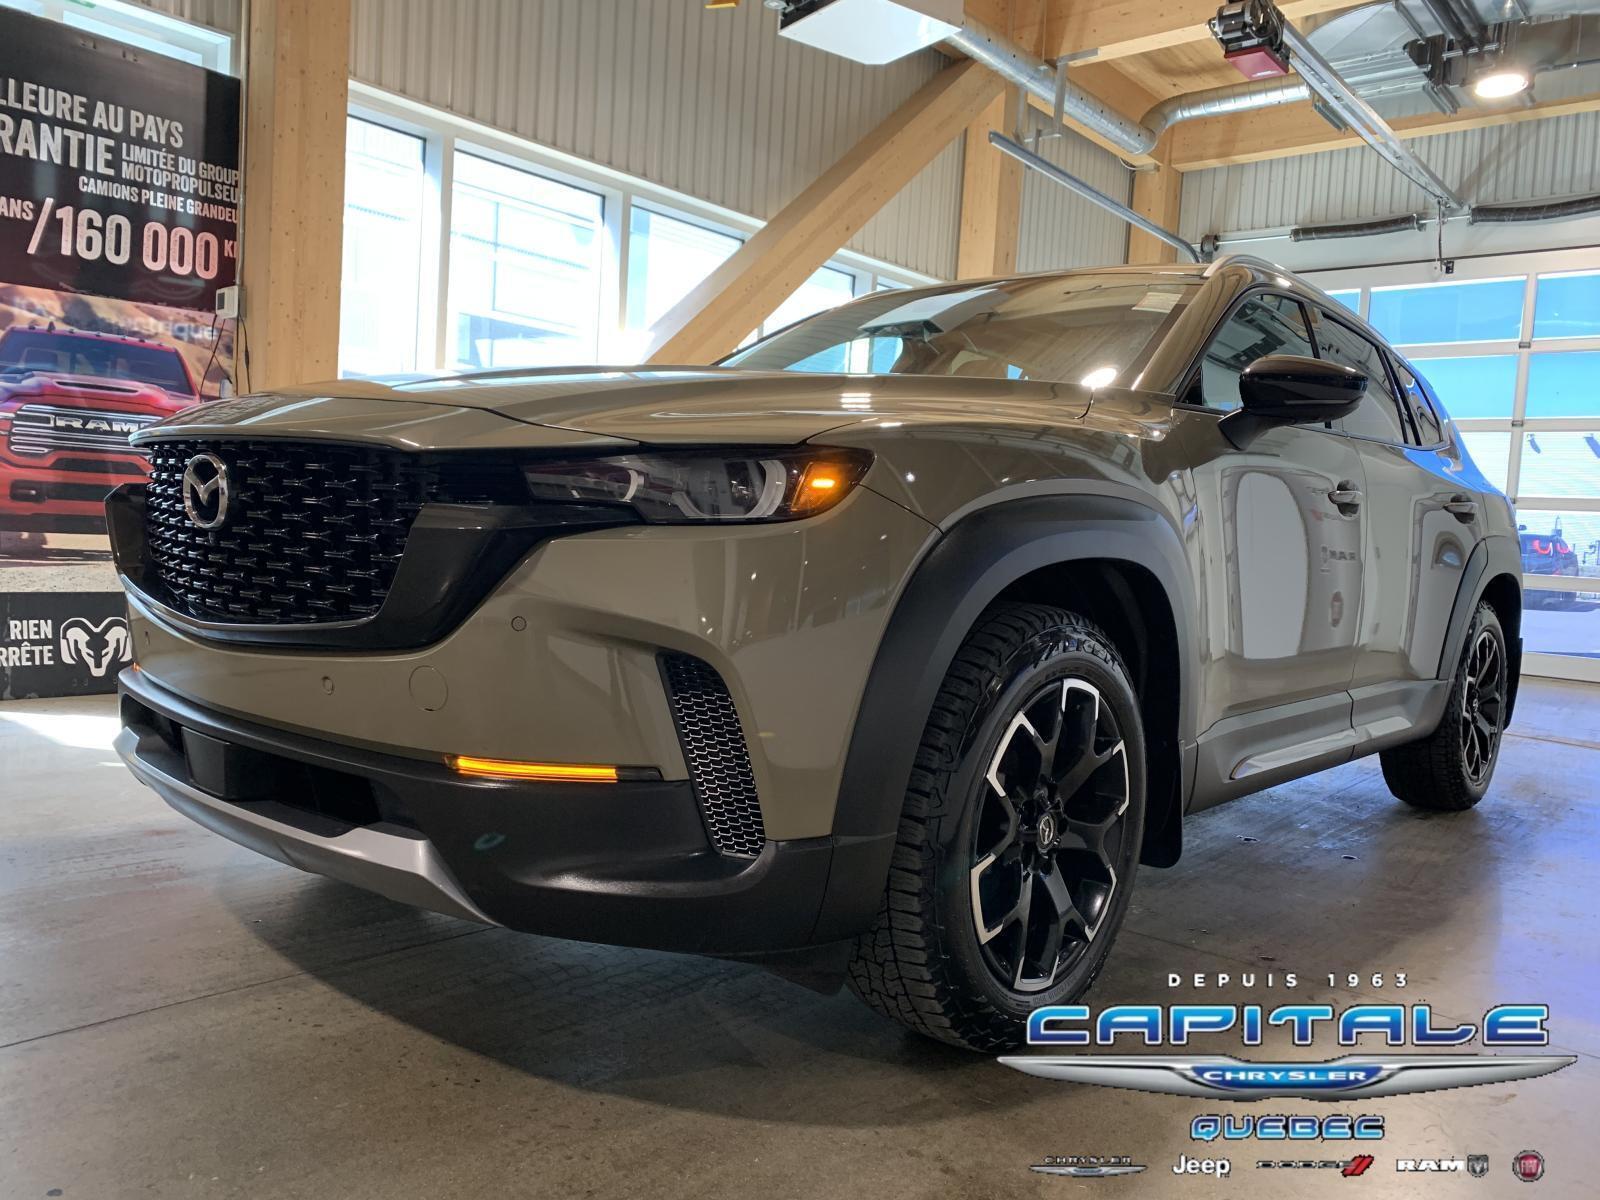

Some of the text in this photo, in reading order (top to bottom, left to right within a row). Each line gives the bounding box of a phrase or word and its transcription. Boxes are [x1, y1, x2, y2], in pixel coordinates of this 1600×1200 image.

[93, 101, 123, 133] AU
[130, 110, 183, 148] PAYS
[0, 113, 115, 176] RANTIE
[122, 142, 175, 170] LIMITÉE
[179, 156, 196, 176] DU
[79, 176, 139, 203] CAMIONS
[141, 190, 184, 213] PLEINE
[142, 222, 218, 280] 000
[54, 416, 139, 433] RAM
[9, 619, 52, 640] RIEN
